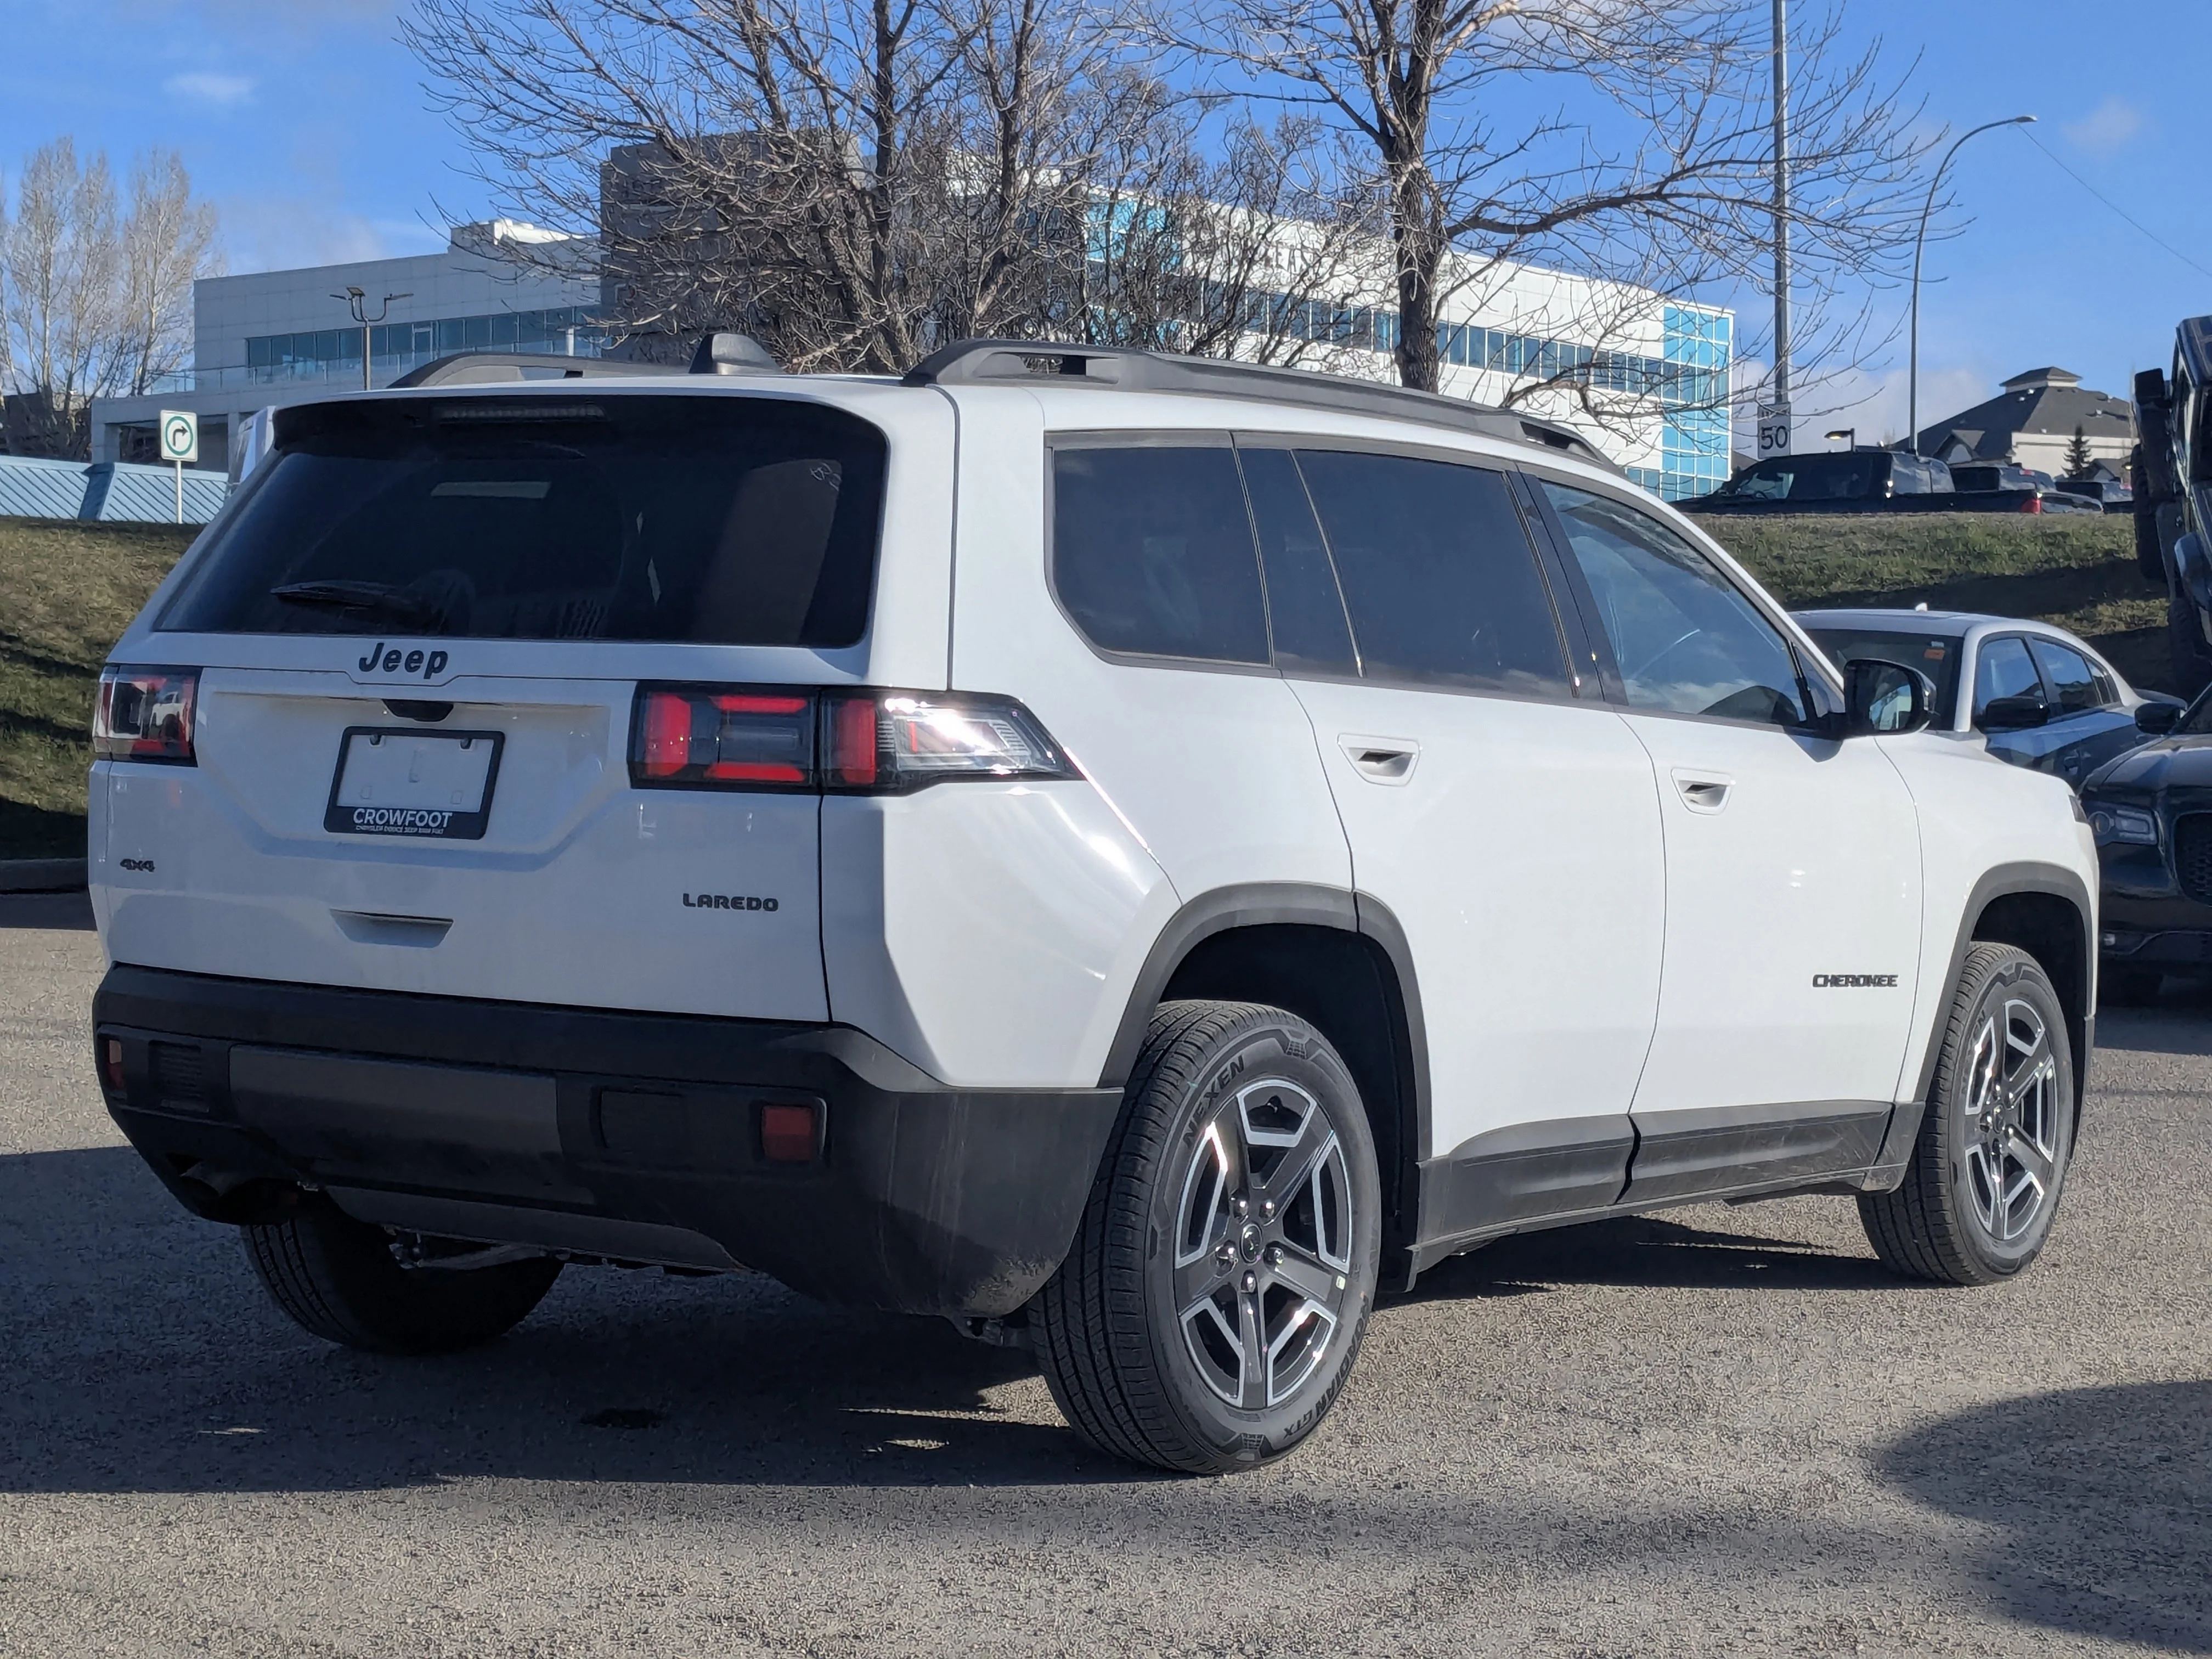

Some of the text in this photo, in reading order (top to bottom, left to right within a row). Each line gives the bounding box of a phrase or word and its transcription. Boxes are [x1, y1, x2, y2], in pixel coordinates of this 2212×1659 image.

[1761, 425, 1788, 449] 50
[359, 642, 448, 679] Jeep
[353, 808, 453, 828] CROWFOOT
[683, 893, 779, 911] LAREDO
[1813, 974, 1898, 988] CHEROKEE
[1183, 1055, 1244, 1148] NEXEN
[1283, 1409, 1313, 1440] GTX
